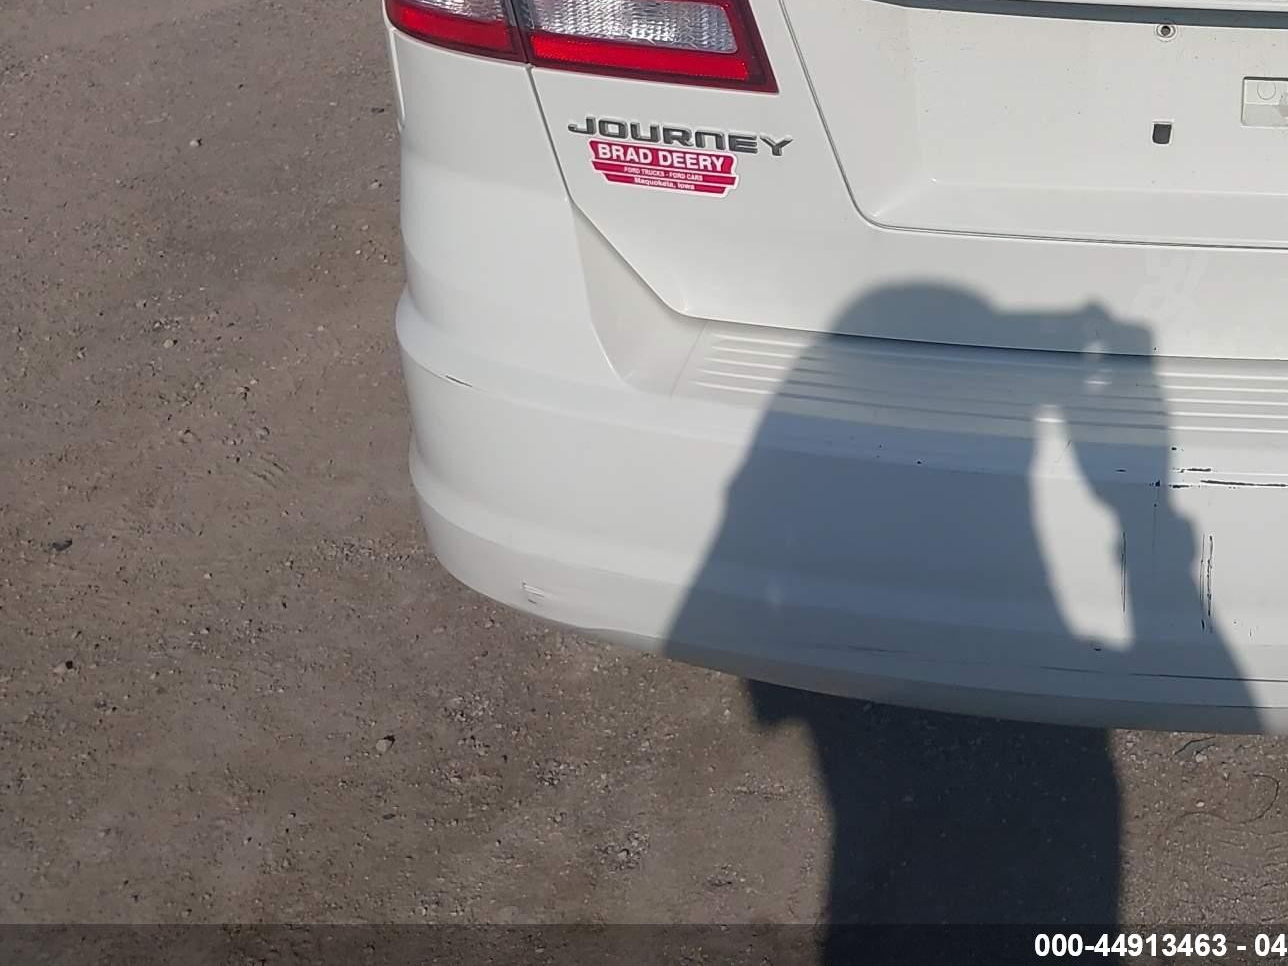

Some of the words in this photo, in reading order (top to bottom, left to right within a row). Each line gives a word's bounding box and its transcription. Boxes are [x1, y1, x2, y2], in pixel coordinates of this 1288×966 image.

[567, 115, 794, 157] JOURNEY
[597, 143, 653, 164] BRAD
[658, 151, 725, 172] DEERY
[623, 166, 641, 174] FORD
[641, 168, 665, 177] TRUCKS
[669, 171, 686, 179] FORD
[686, 173, 704, 181] CARS
[677, 182, 695, 190] Iowa
